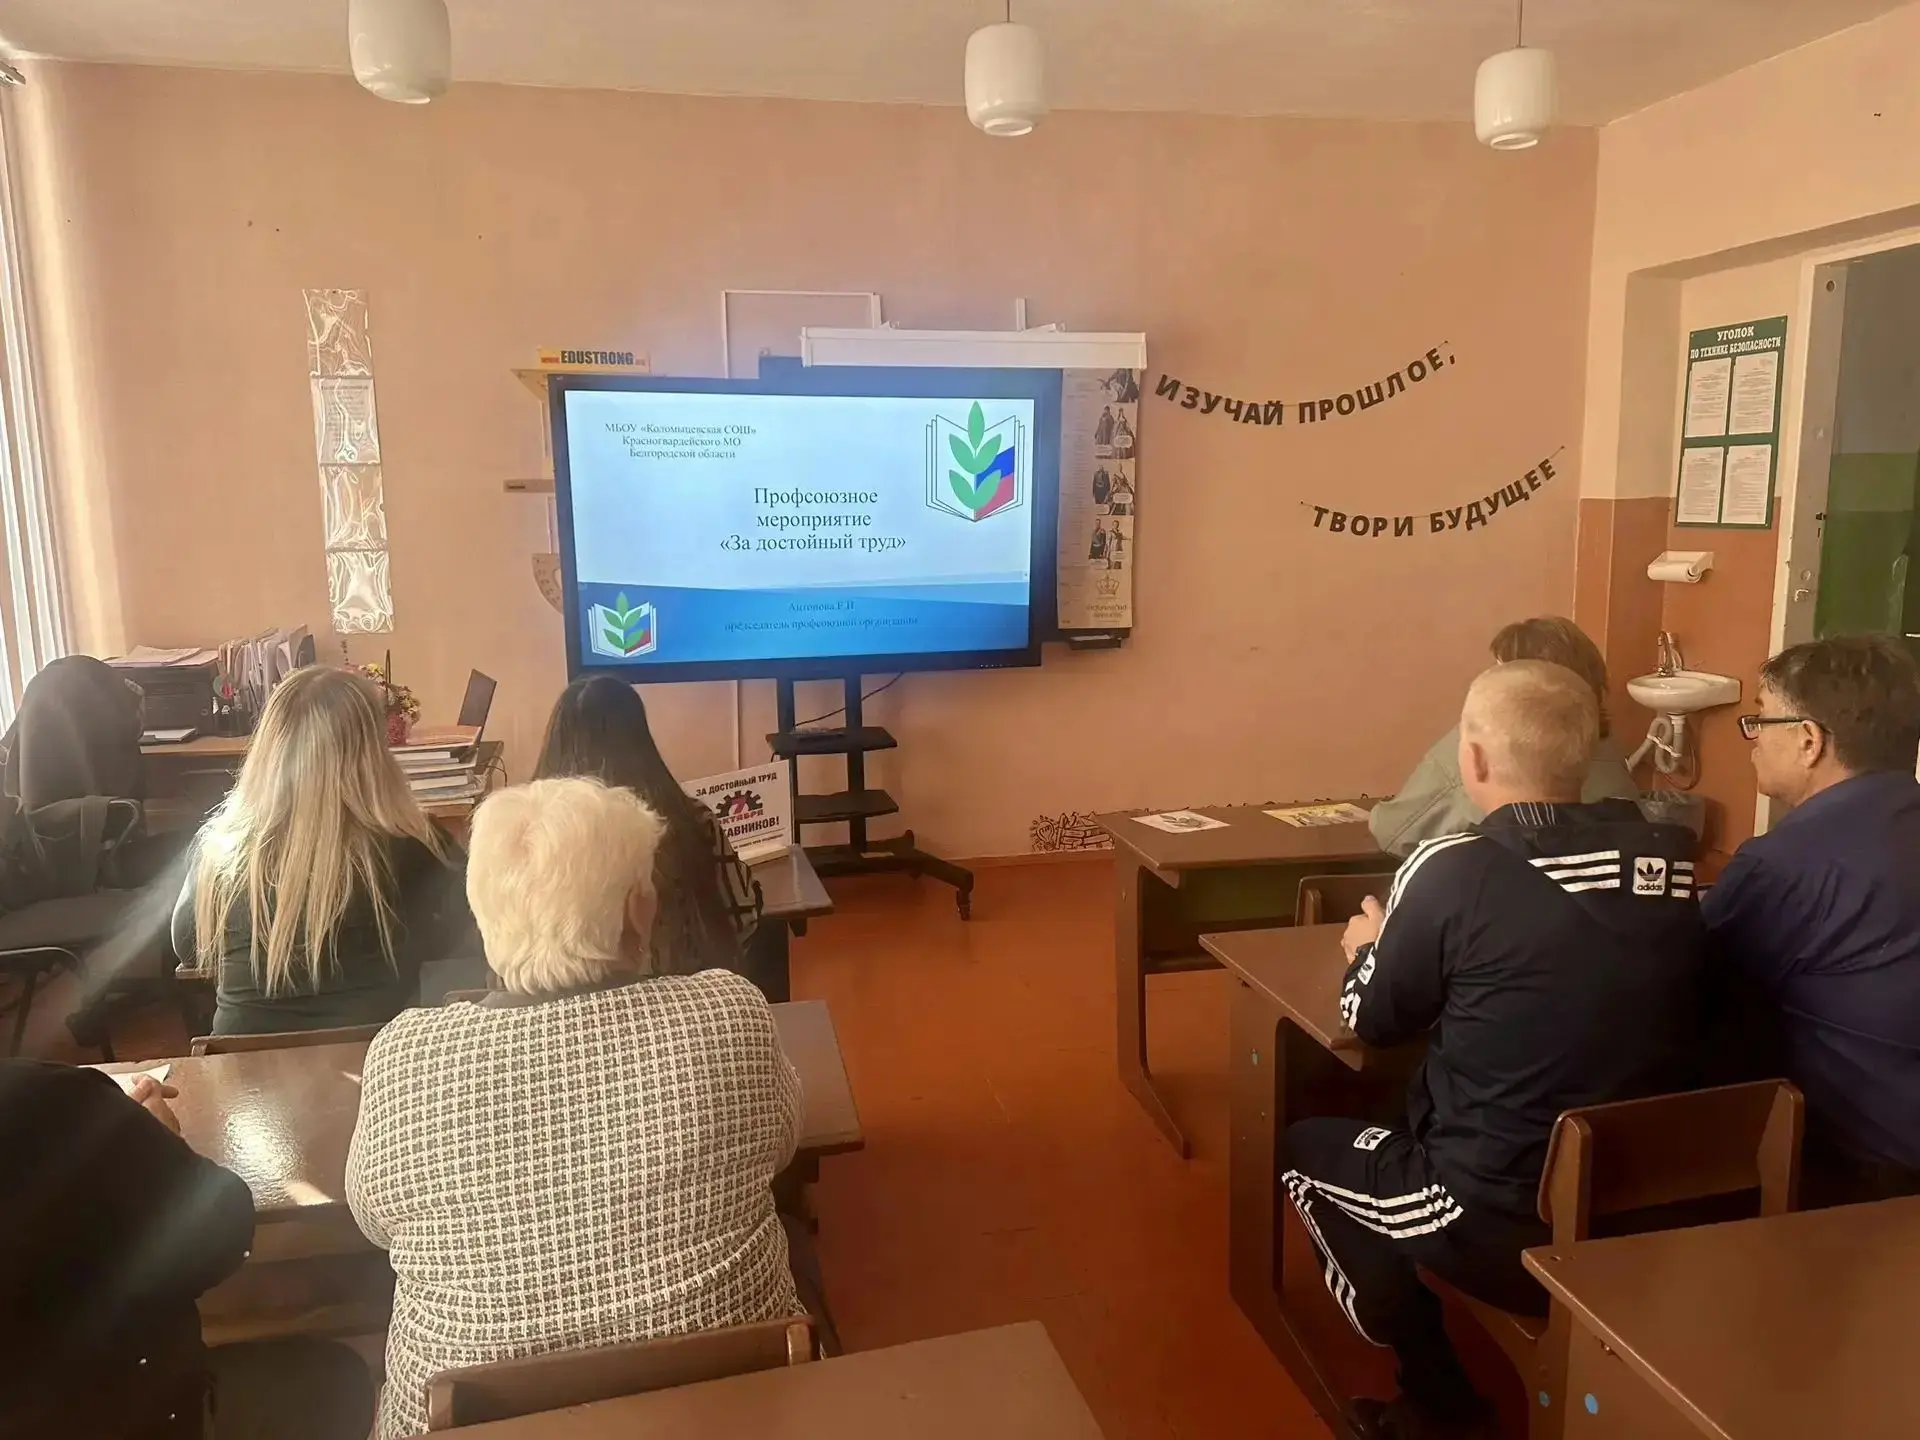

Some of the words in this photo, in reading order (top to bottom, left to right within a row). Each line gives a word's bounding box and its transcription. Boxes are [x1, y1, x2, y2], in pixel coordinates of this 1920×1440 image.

[1717, 326, 1755, 341] УГОЛОК
[1690, 349, 1700, 359] ПО
[1700, 344, 1729, 358] ТЕХНИКЕ
[1730, 336, 1782, 354] БЕЗОПАСНОСТИ
[560, 350, 634, 365] EDUSTRONG
[1155, 374, 1284, 426] ИЗУЧАЙ
[1298, 348, 1456, 424] ПРОШЛОЕ,
[605, 423, 637, 433] МБОУ
[724, 424, 757, 435] СОШ»
[622, 435, 721, 448] Красногвардейского
[723, 437, 742, 447] МО
[629, 448, 696, 460] Белгородской
[698, 448, 736, 459] области
[754, 487, 879, 508] Профсоюзное
[1313, 505, 1414, 537] ТВОРИ
[1429, 458, 1556, 533] БУДУЩЕЕ
[756, 514, 872, 531] мероприятие
[720, 534, 750, 550] «За
[756, 534, 853, 552] достойный
[857, 536, 906, 553] труд»
[695, 788, 707, 797] ЗА
[708, 776, 757, 796] ДОСТОЙНЫЙ
[758, 772, 777, 784] ТРУД
[731, 796, 747, 815] 7
[1637, 883, 1663, 892] adidas
